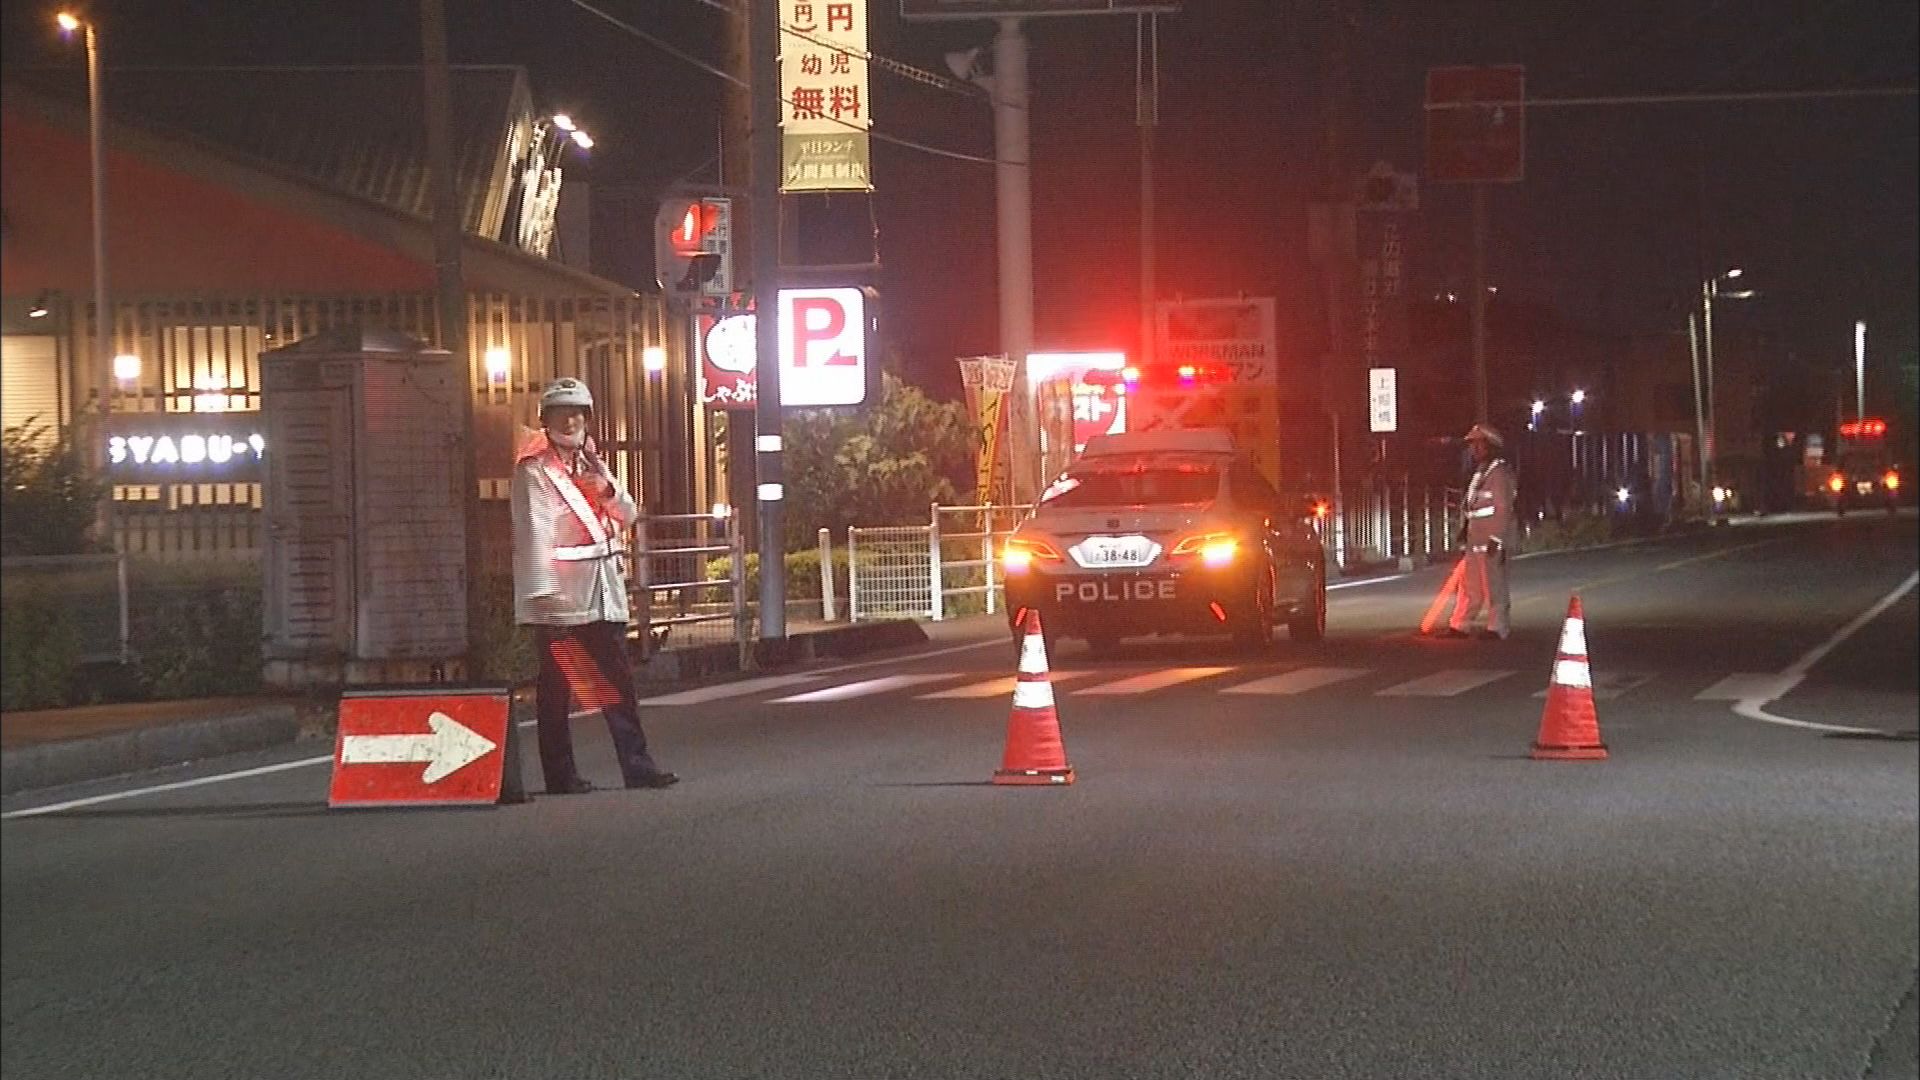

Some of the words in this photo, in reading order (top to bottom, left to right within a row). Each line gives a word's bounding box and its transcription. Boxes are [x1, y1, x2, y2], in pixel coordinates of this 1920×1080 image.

[801, 53, 850, 75] 幼児
[791, 84, 860, 120] 無料
[1056, 579, 1176, 603] POLICE
